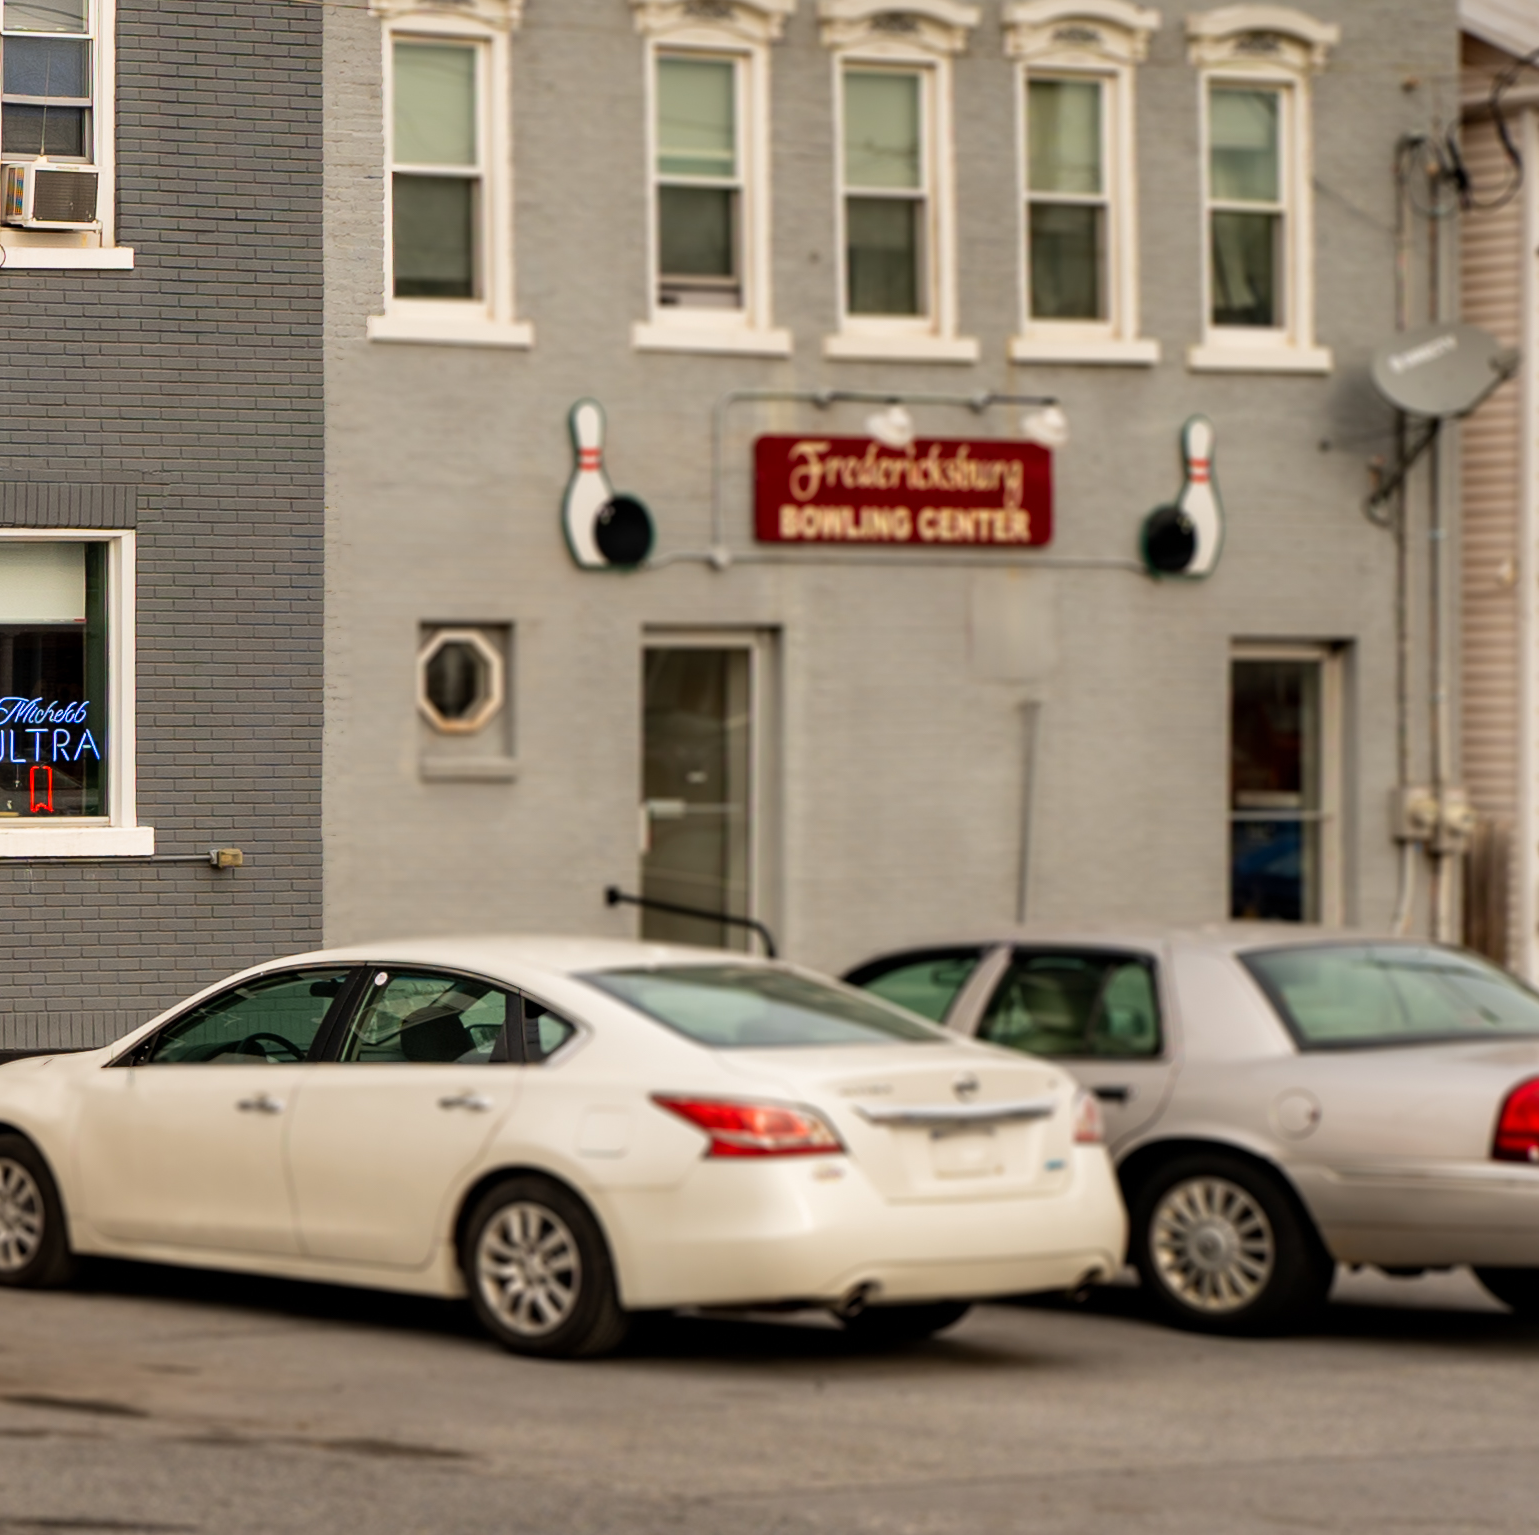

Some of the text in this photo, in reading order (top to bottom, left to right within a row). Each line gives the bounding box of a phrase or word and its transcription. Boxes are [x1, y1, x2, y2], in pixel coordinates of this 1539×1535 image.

[787, 440, 1023, 508] Fredericksburg
[779, 503, 1032, 542] BOWLING CENTER
